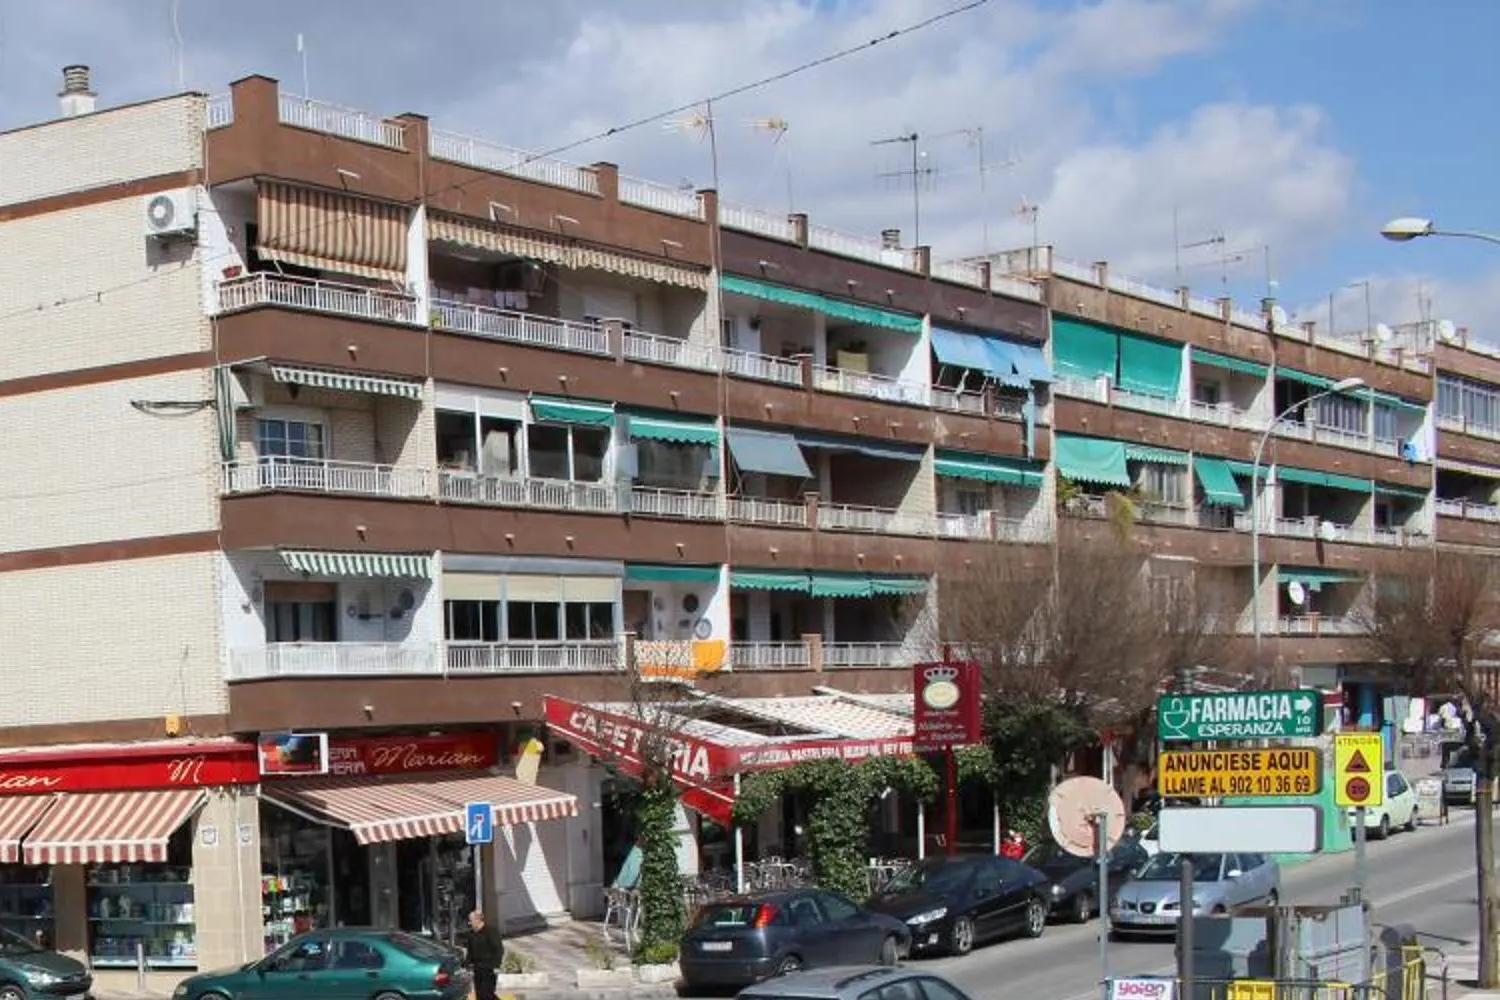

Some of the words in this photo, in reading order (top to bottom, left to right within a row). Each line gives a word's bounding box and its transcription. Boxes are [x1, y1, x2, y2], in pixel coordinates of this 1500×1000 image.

[1190, 694, 1293, 723] FARMACIA
[1197, 722, 1285, 737] ESPERANZA
[371, 743, 485, 769] Marian
[569, 710, 712, 782] CAFETRIA
[1165, 753, 1262, 773] ANUNCIESE
[1267, 751, 1310, 772] AQUI
[1164, 776, 1206, 795] LLAME
[1209, 777, 1227, 794] AL
[1229, 775, 1253, 794] 902
[1257, 775, 1272, 794] 10
[1275, 775, 1291, 793] 36
[1294, 774, 1311, 793] 69
